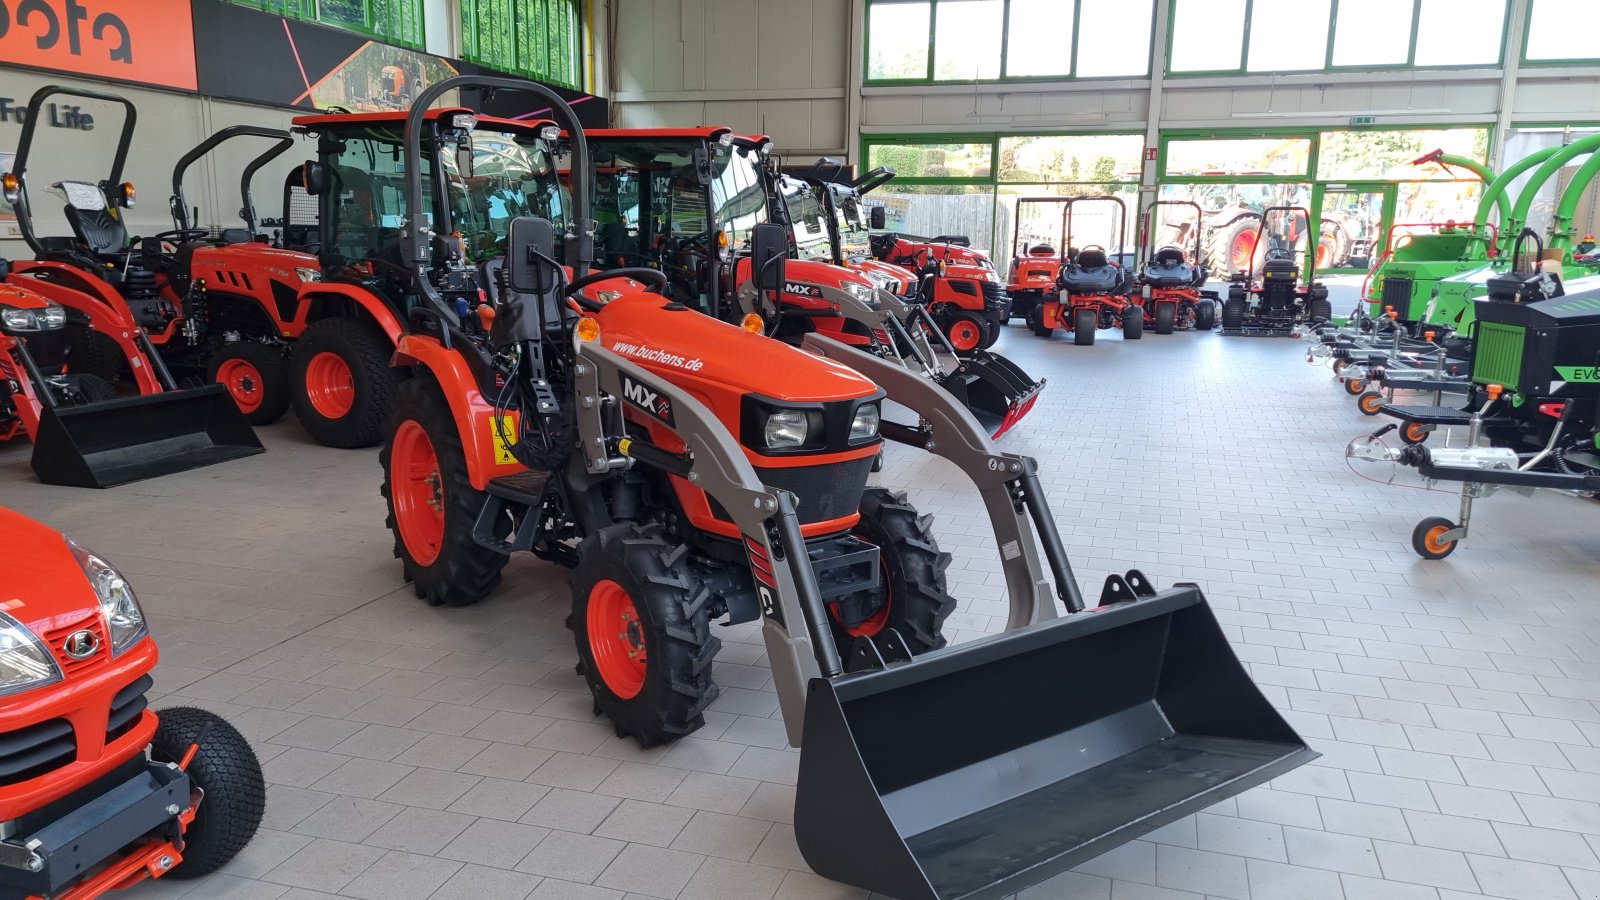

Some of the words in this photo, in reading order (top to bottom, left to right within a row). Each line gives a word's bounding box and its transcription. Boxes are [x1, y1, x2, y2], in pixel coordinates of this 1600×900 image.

[0, 0, 133, 64] ota
[0, 97, 38, 124] Fo
[50, 103, 95, 131] Life
[786, 283, 810, 295] MX
[612, 341, 704, 371] www.buchens.de
[624, 377, 656, 413] MX
[760, 586, 774, 616] C1
